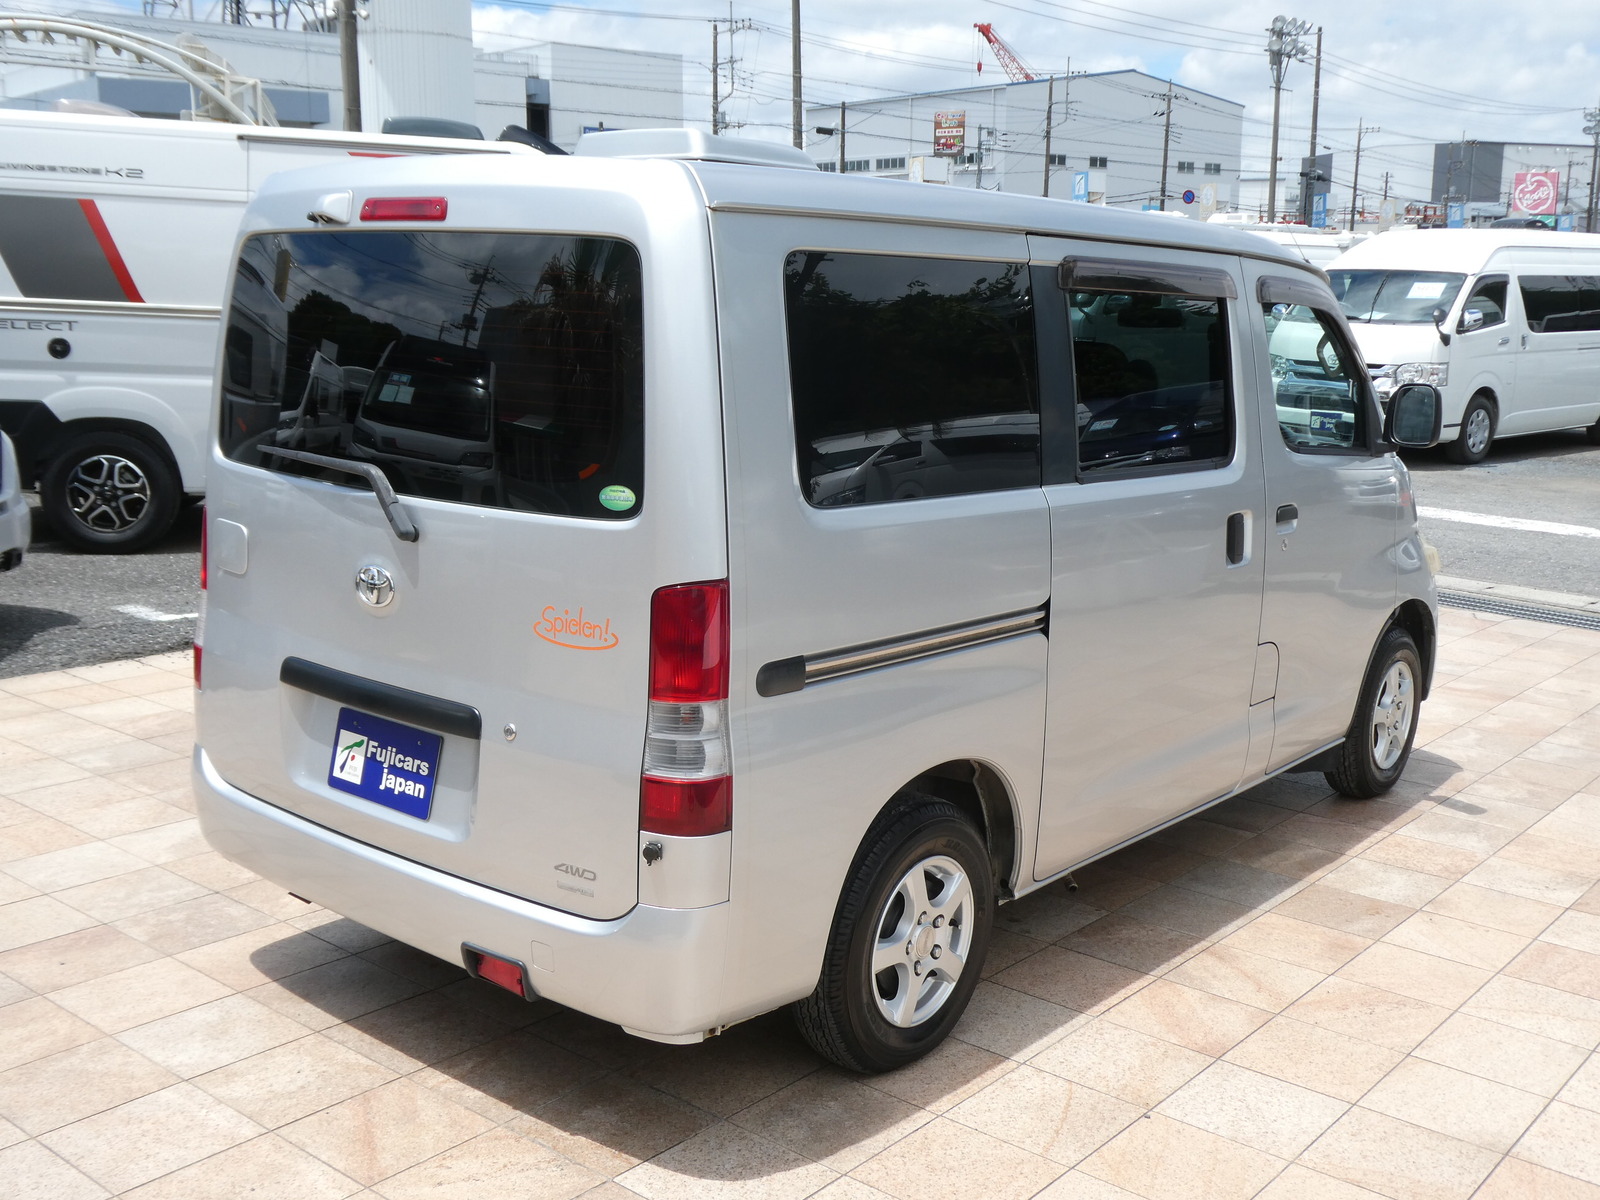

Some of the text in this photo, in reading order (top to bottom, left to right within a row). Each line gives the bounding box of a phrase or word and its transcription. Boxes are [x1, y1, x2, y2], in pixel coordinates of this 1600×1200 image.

[105, 167, 144, 179] K2
[541, 605, 610, 643] Spielen!
[366, 740, 429, 776] Fujicars
[379, 768, 425, 799] japan
[553, 862, 597, 881] 4WD
